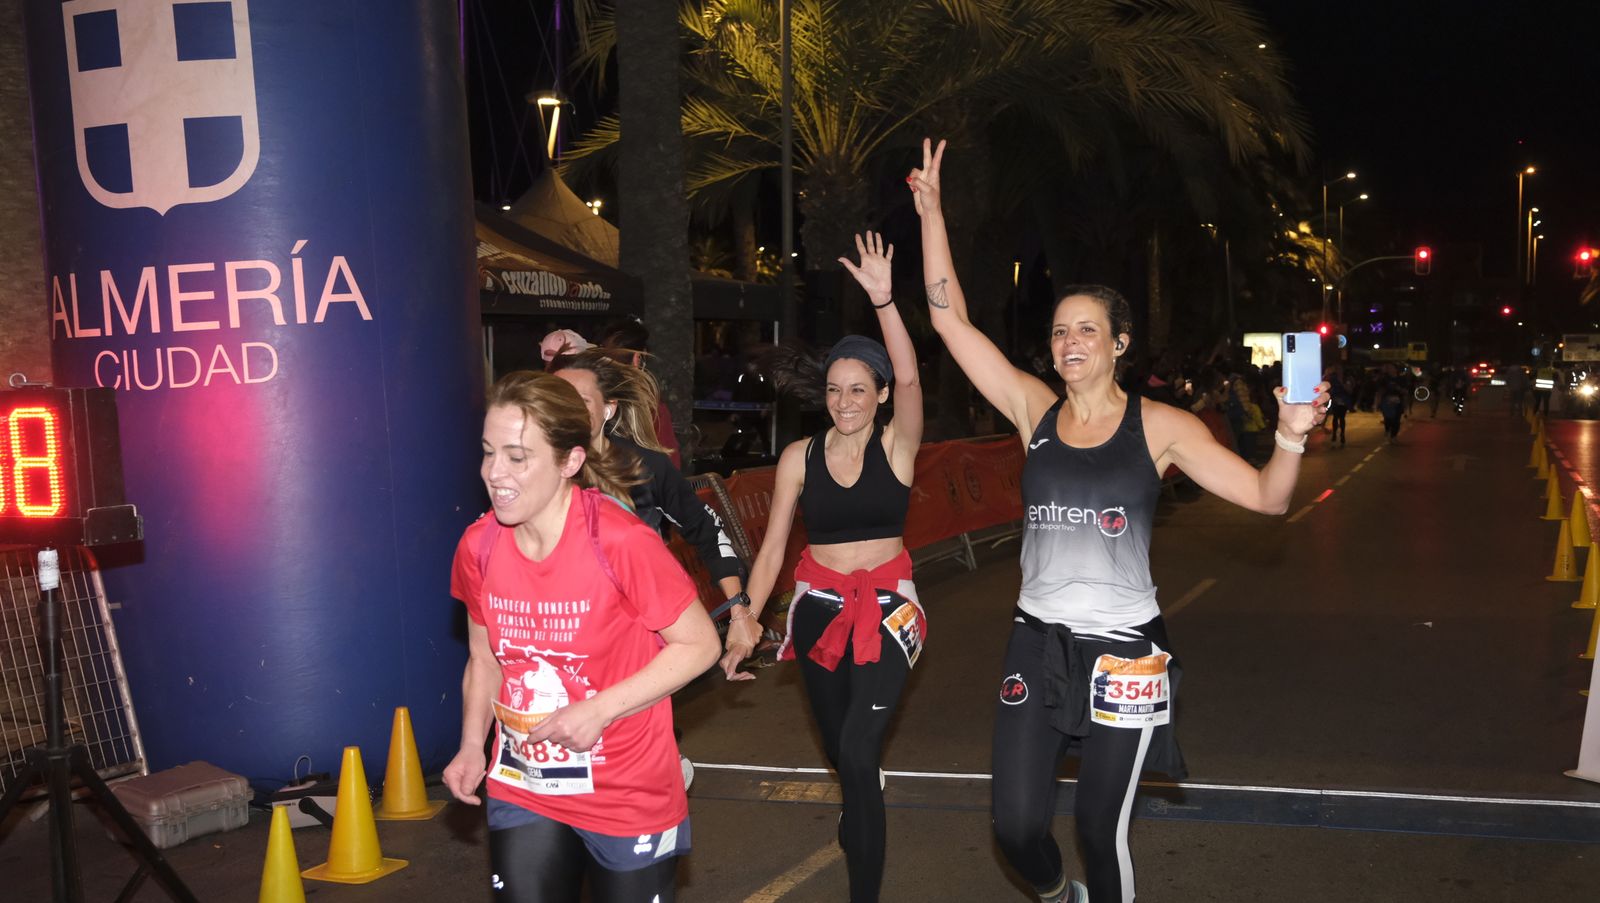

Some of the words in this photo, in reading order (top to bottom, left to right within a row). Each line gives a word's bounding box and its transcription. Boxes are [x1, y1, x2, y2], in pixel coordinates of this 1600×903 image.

[52, 239, 373, 340] ALMERÍA
[94, 342, 279, 391] CIUDAD
[543, 617, 580, 630] CIUDAD
[1108, 679, 1162, 700] 3541
[1118, 704, 1137, 713] MARTA
[510, 735, 570, 763] 3483
